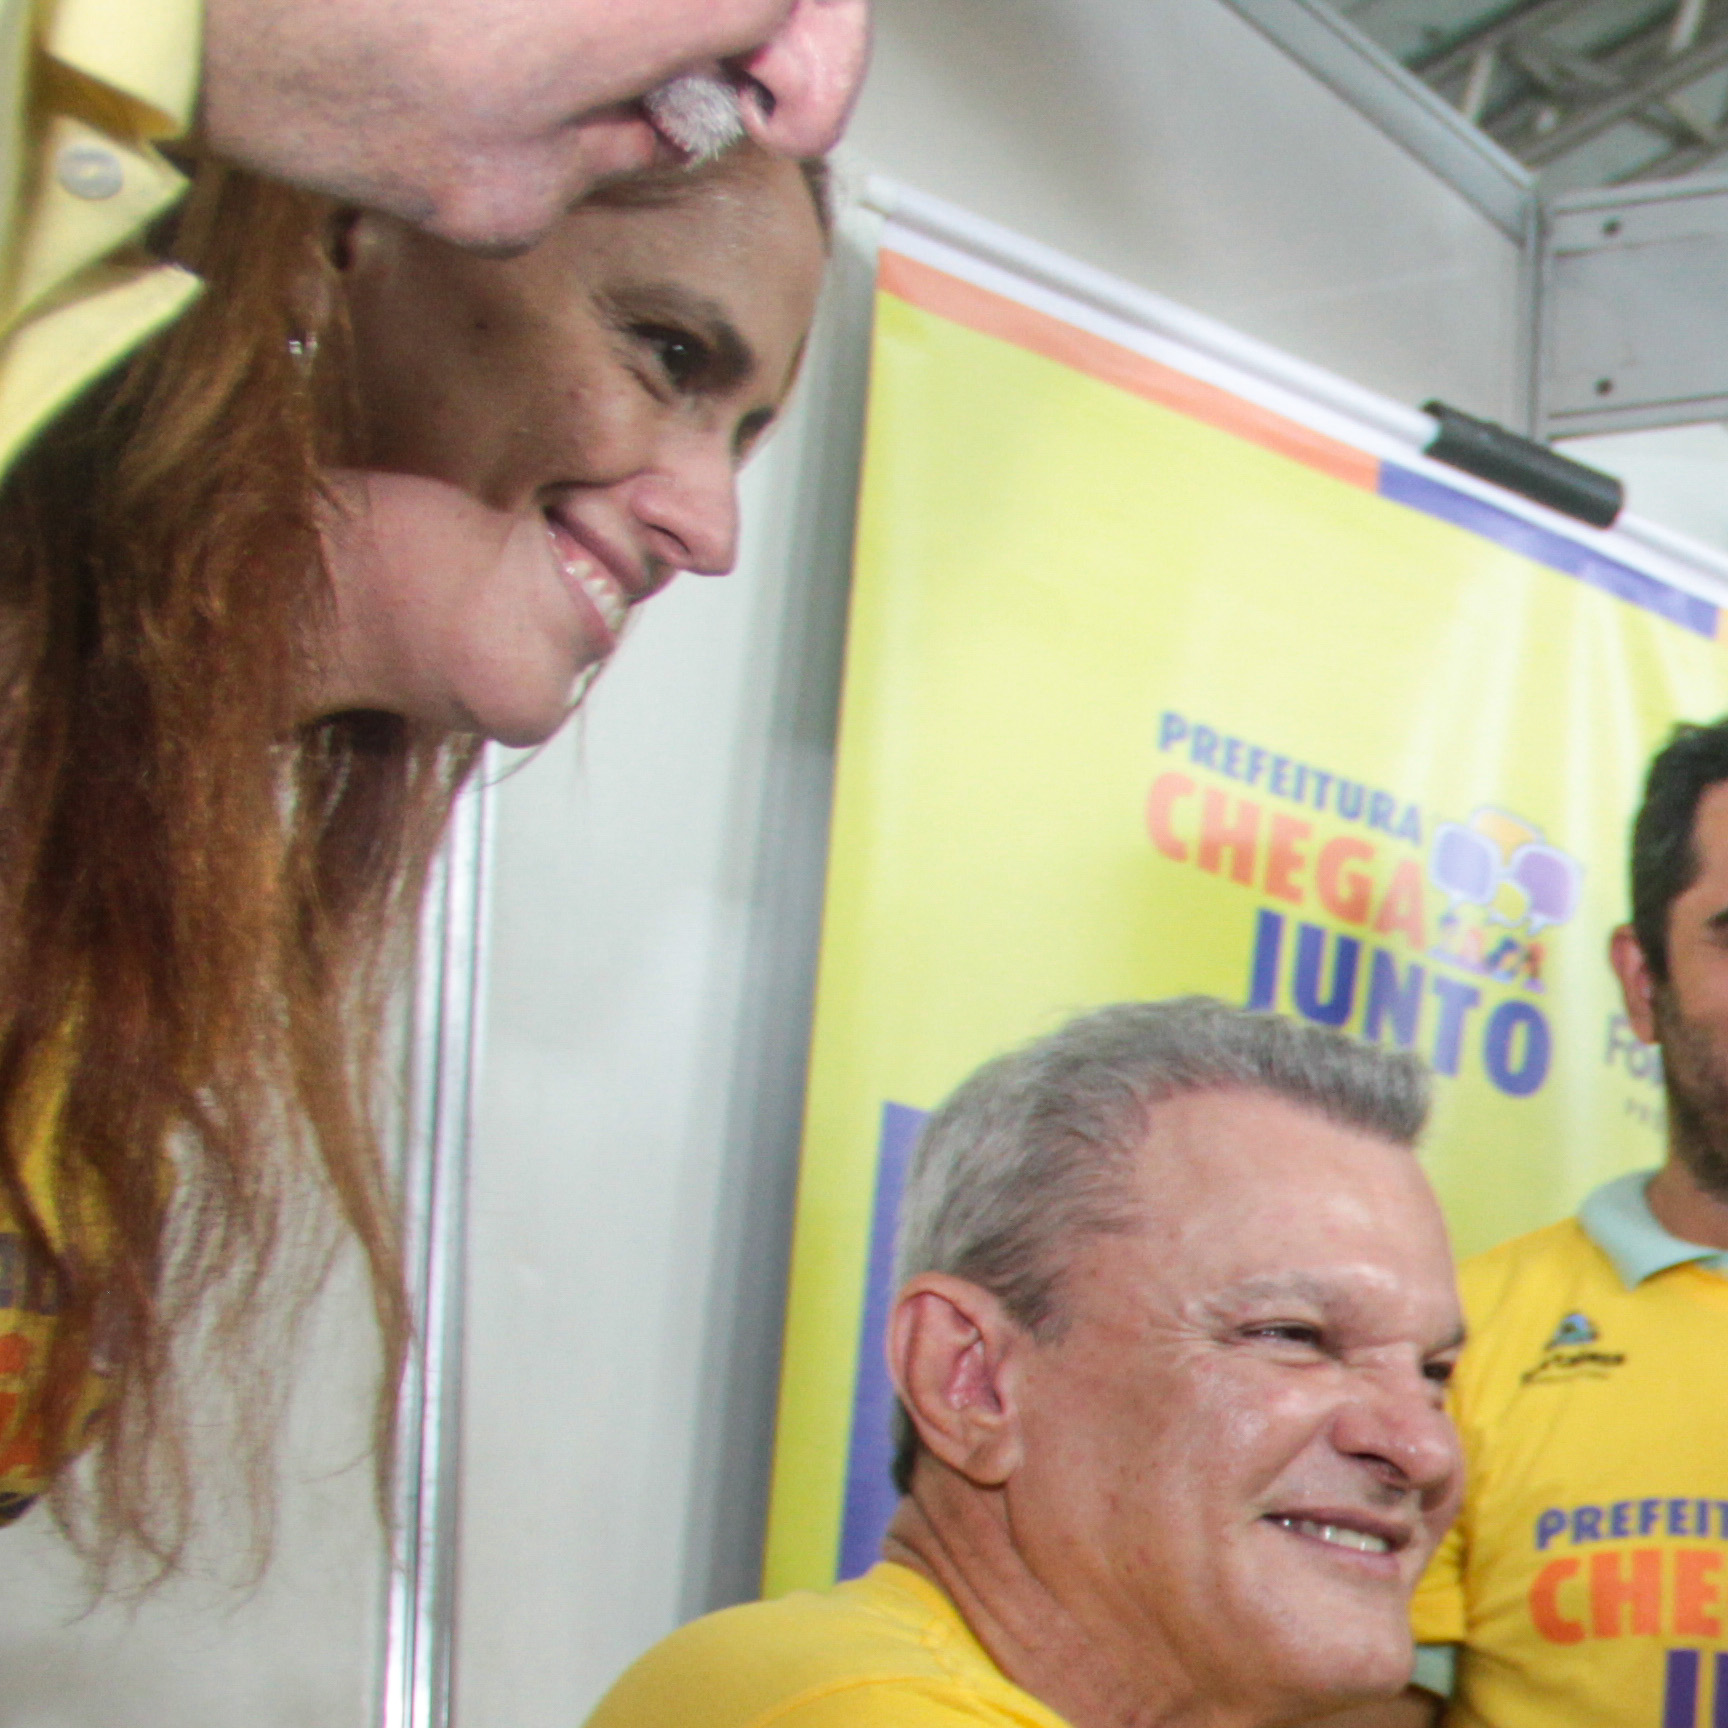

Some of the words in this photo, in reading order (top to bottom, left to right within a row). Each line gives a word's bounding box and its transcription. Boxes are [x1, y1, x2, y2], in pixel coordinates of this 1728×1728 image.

[1145, 771, 1426, 952] CHEGA
[1158, 711, 1422, 847] PREFEITURA
[1247, 907, 1552, 1100] JUNTO
